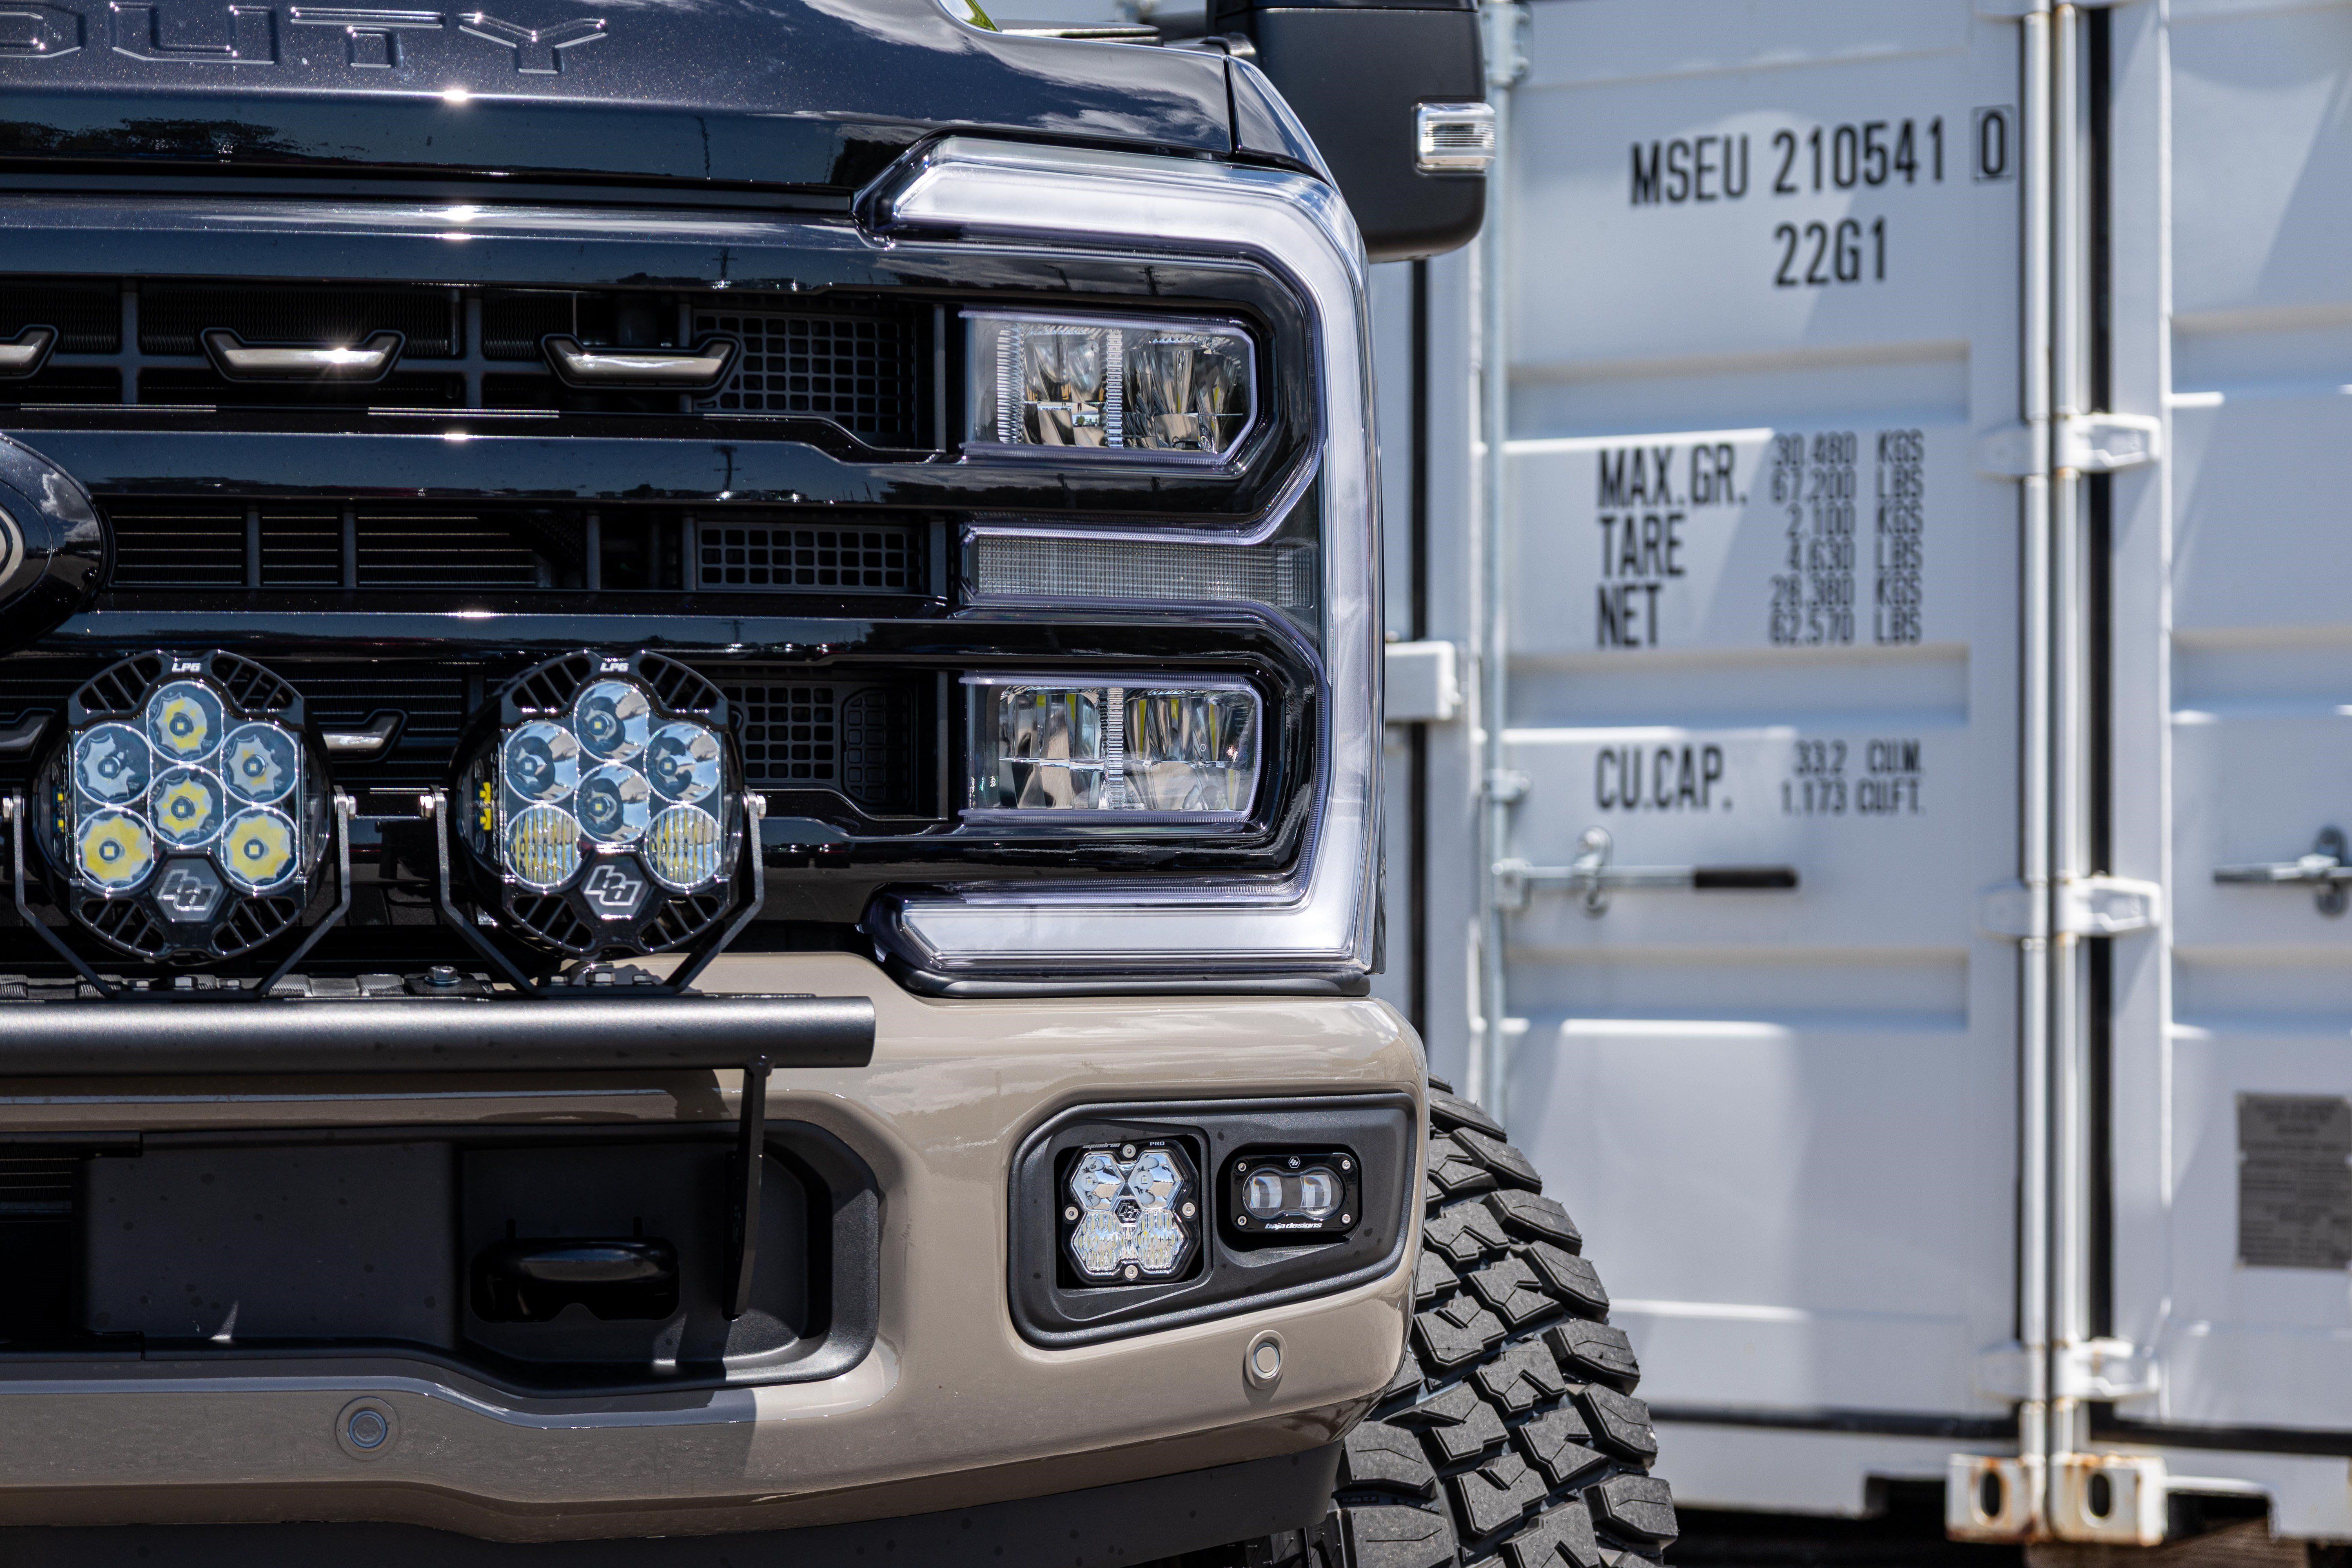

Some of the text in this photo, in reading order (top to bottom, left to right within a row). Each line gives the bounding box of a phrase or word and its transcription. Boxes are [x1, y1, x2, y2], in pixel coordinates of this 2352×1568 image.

[1630, 133, 1751, 207] MSEU
[1772, 115, 1944, 195] 210541
[1774, 216, 1886, 288] 22G1
[1876, 429, 1924, 463] KGS
[1875, 464, 1924, 499] LBS
[1597, 512, 1686, 577] TARE
[1876, 500, 1924, 535] KGS
[1875, 535, 1923, 571] LBS
[1597, 583, 1662, 648] NET
[1875, 570, 1923, 606] KGS
[1874, 606, 1922, 644] LBS
[172, 662, 201, 673] LP6
[600, 662, 629, 673] LP6
